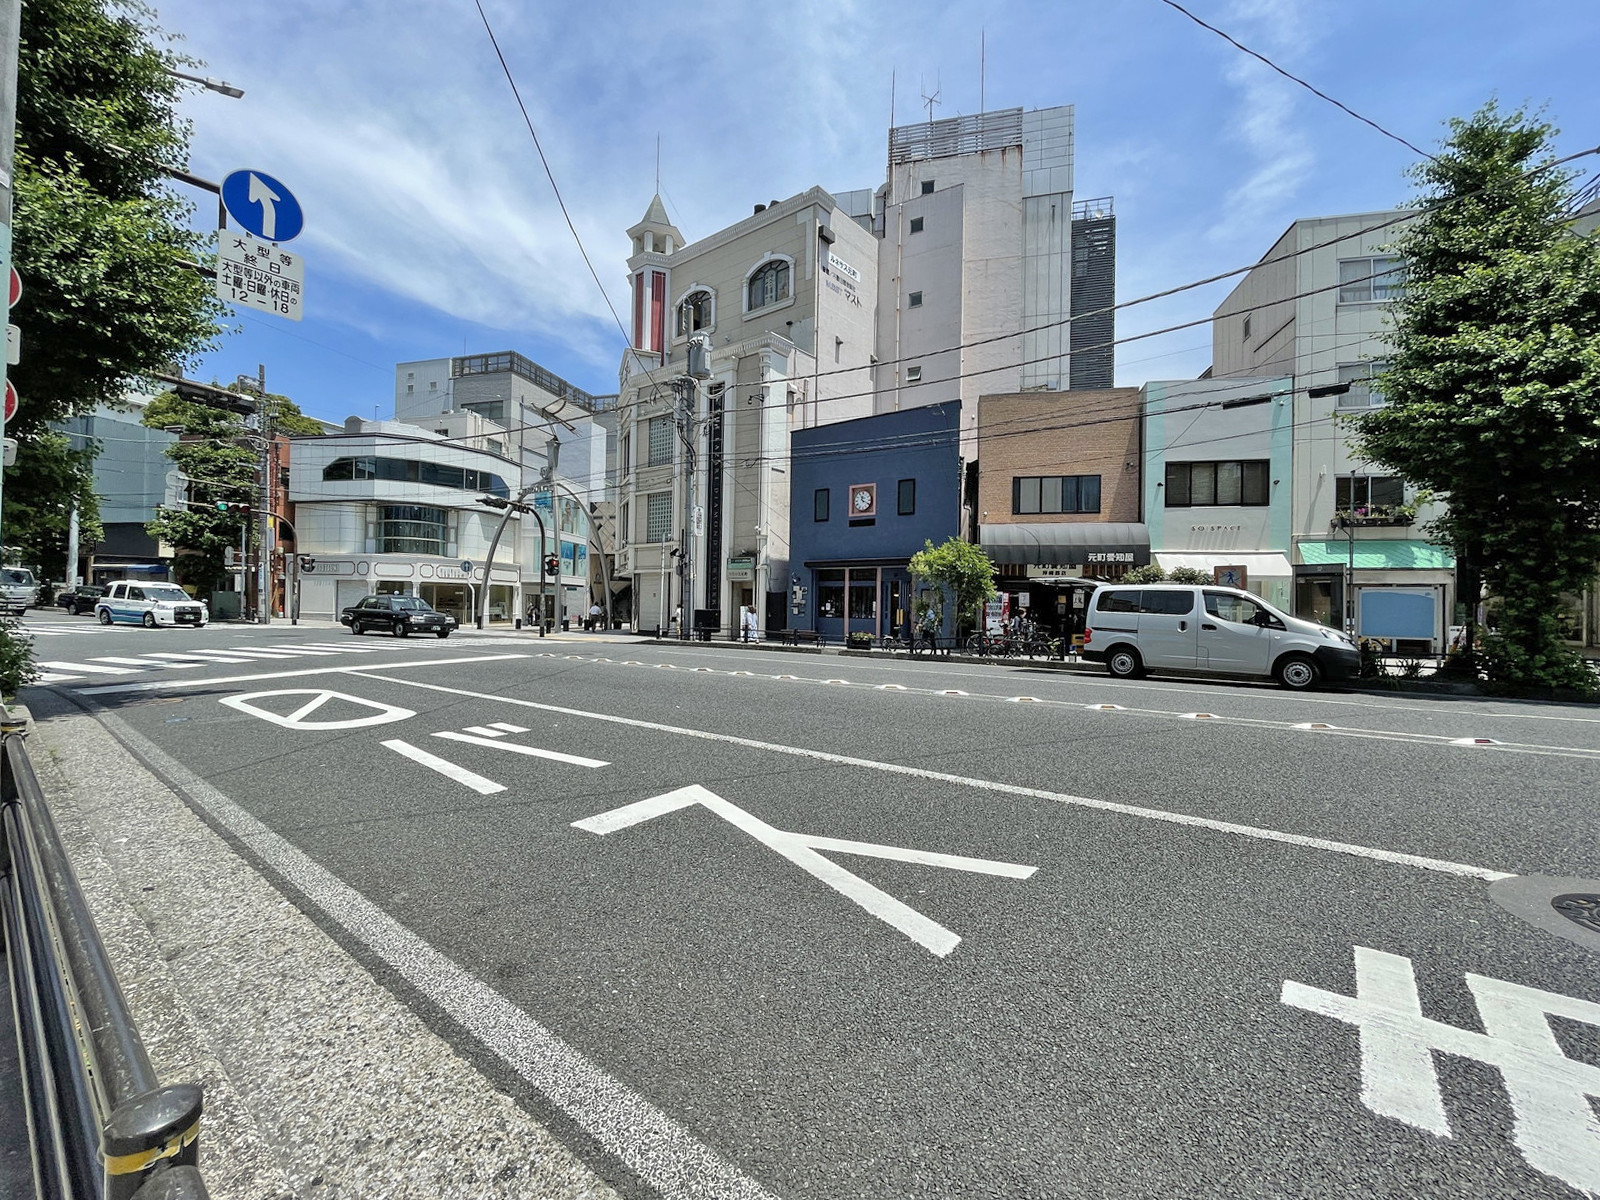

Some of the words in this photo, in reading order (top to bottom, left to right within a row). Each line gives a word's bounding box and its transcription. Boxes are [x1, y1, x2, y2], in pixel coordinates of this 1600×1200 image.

[233, 238, 292, 267] 大型等
[243, 253, 281, 274] 終日
[222, 261, 300, 295] 大型等以外の車両
[1088, 552, 1135, 562] 元町愛知屋
